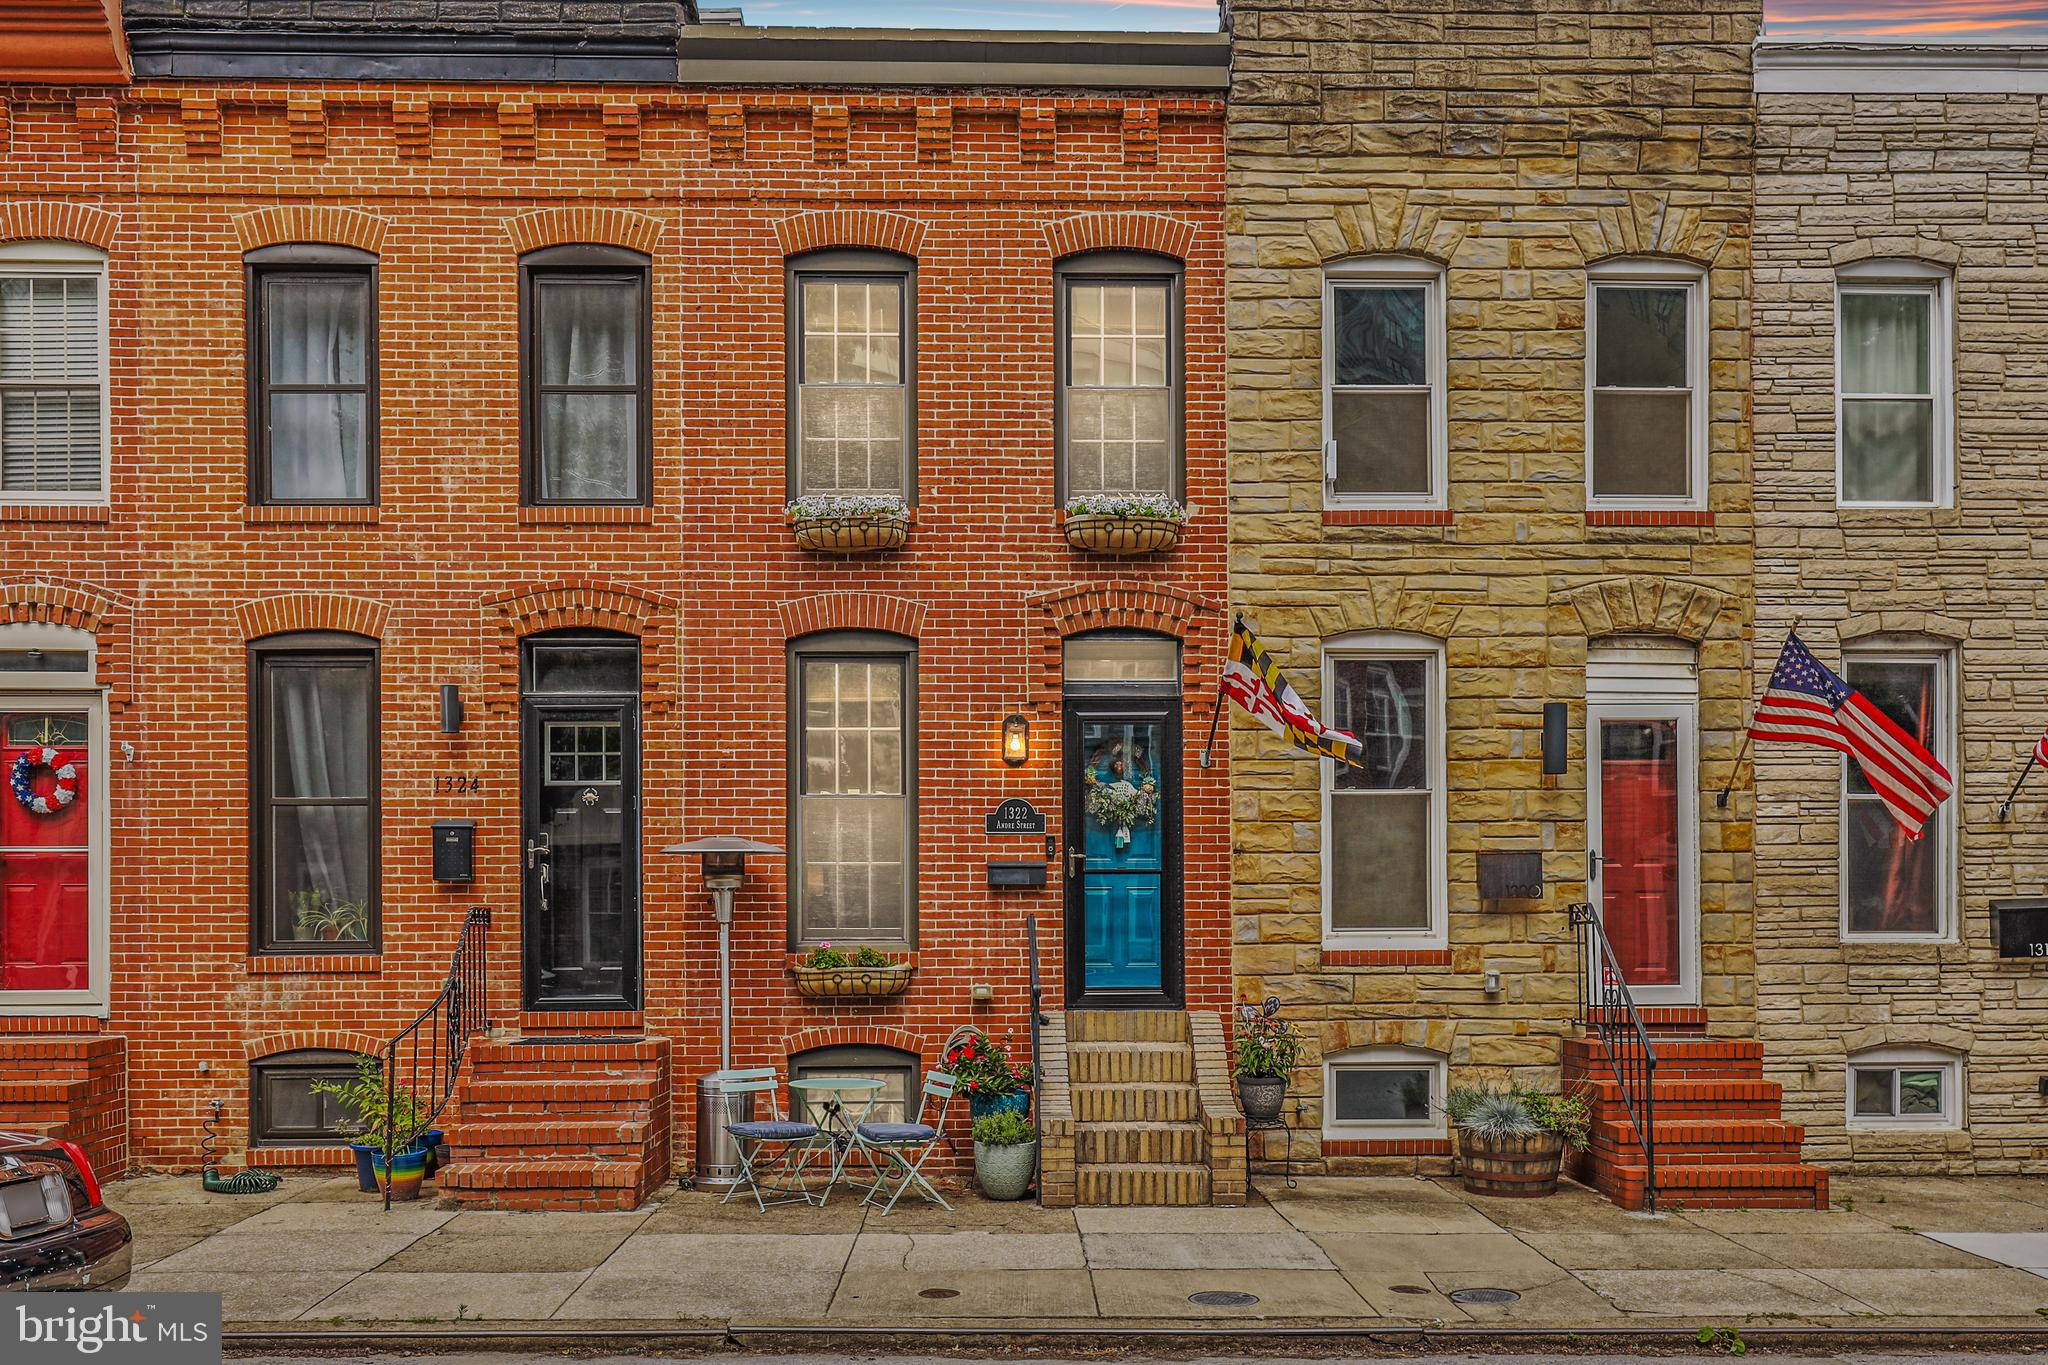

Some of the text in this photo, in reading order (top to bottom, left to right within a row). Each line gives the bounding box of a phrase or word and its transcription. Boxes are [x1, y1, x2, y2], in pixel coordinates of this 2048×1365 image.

[434, 776, 479, 793] 1324
[1004, 806, 1028, 820] 1322
[1016, 820, 1036, 829] STREET
